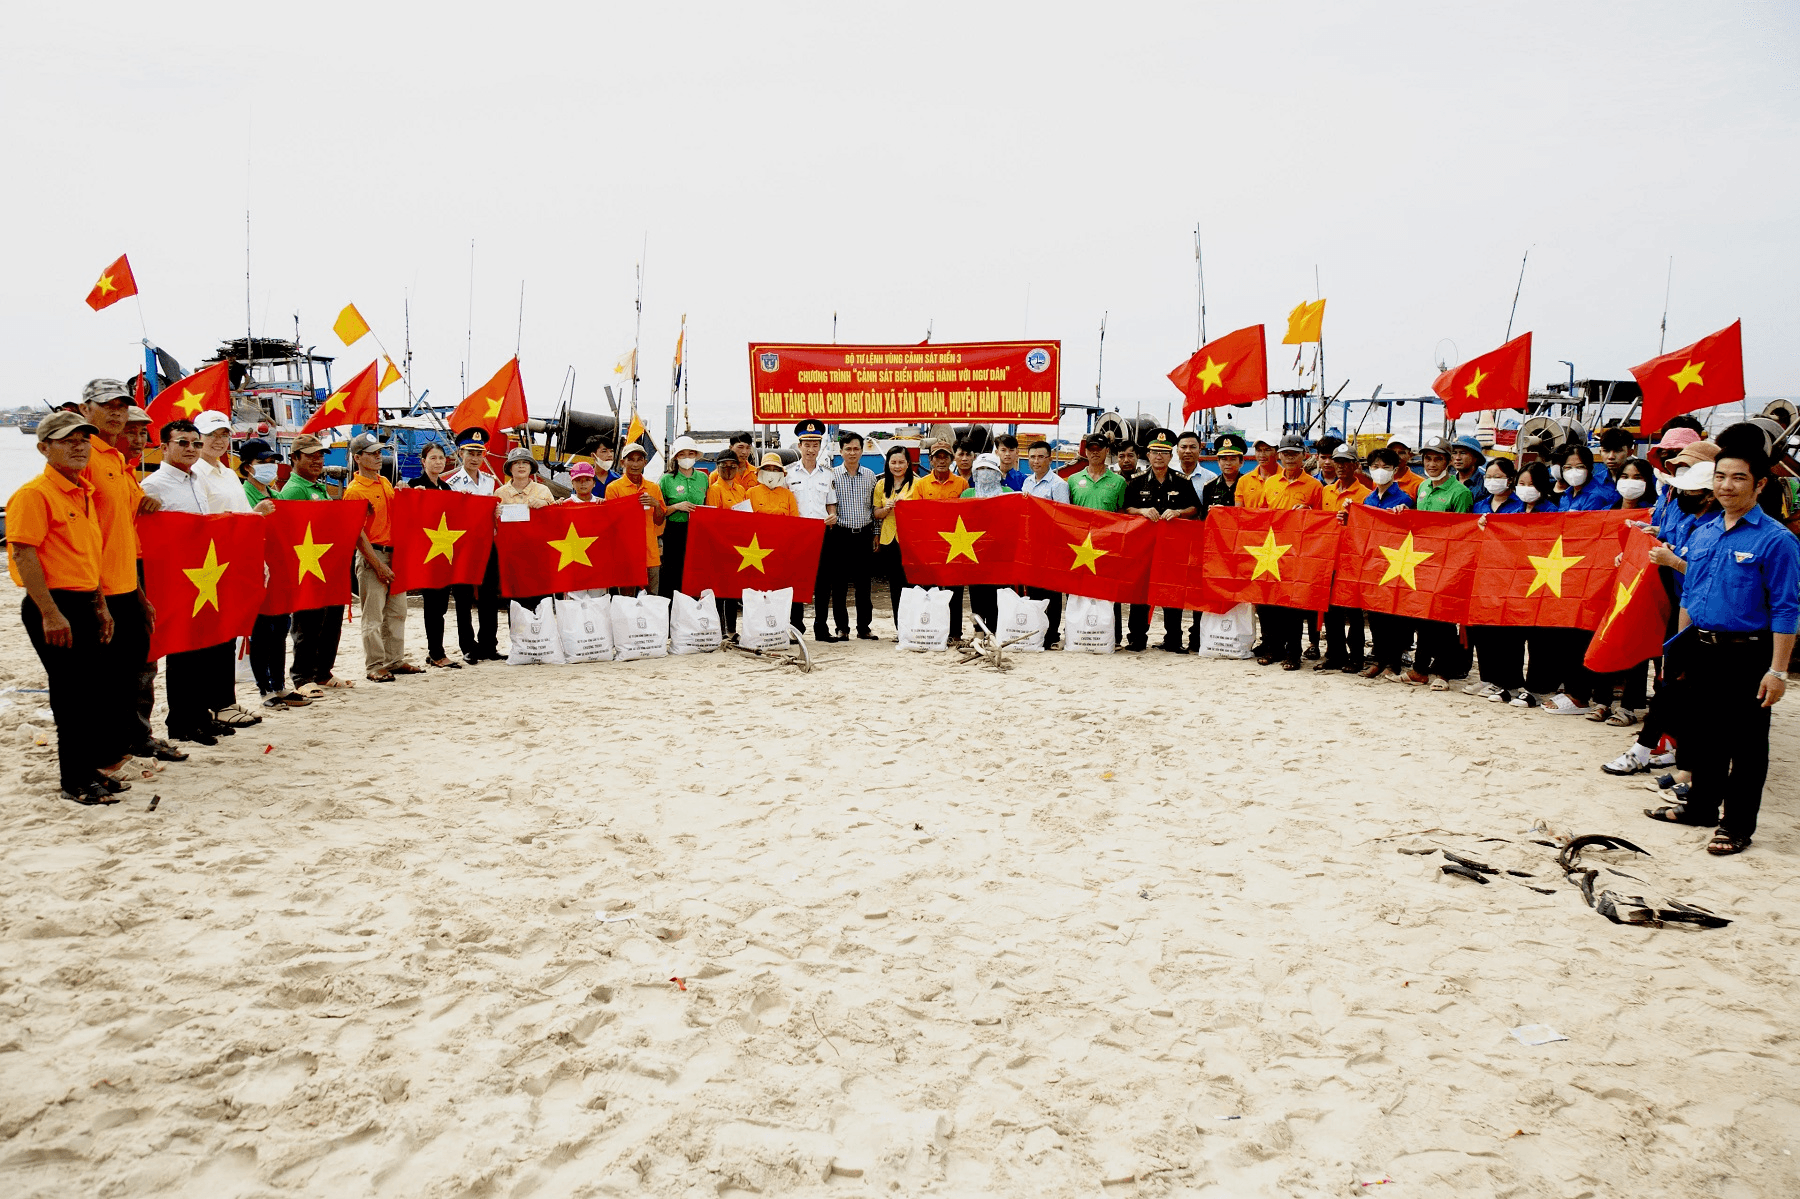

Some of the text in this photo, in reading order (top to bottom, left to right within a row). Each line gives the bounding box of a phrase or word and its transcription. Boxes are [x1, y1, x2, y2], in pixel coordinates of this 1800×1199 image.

[845, 353, 855, 366] BỘ
[856, 354, 865, 364] TƯ
[866, 353, 883, 366] LỆNH
[905, 351, 923, 363] CẢNH
[925, 352, 937, 363] SÁT
[939, 350, 956, 363] BIỂN
[957, 354, 961, 363] 3
[798, 370, 828, 382] CHƯƠNG
[829, 368, 851, 382] TRÌNH
[879, 368, 893, 382] SÁT
[895, 366, 912, 382] BIỂN
[914, 367, 934, 382] ĐỒNG
[936, 368, 957, 382] HÀNH
[958, 368, 971, 381] VỚI
[972, 369, 989, 381] NGƯ
[759, 387, 1051, 418] THĂM TẶNG QUÀ CHO NGƯ DÂN XÃ TÂN THUẬN, HUYỆN HÀM THUẬN NAM
